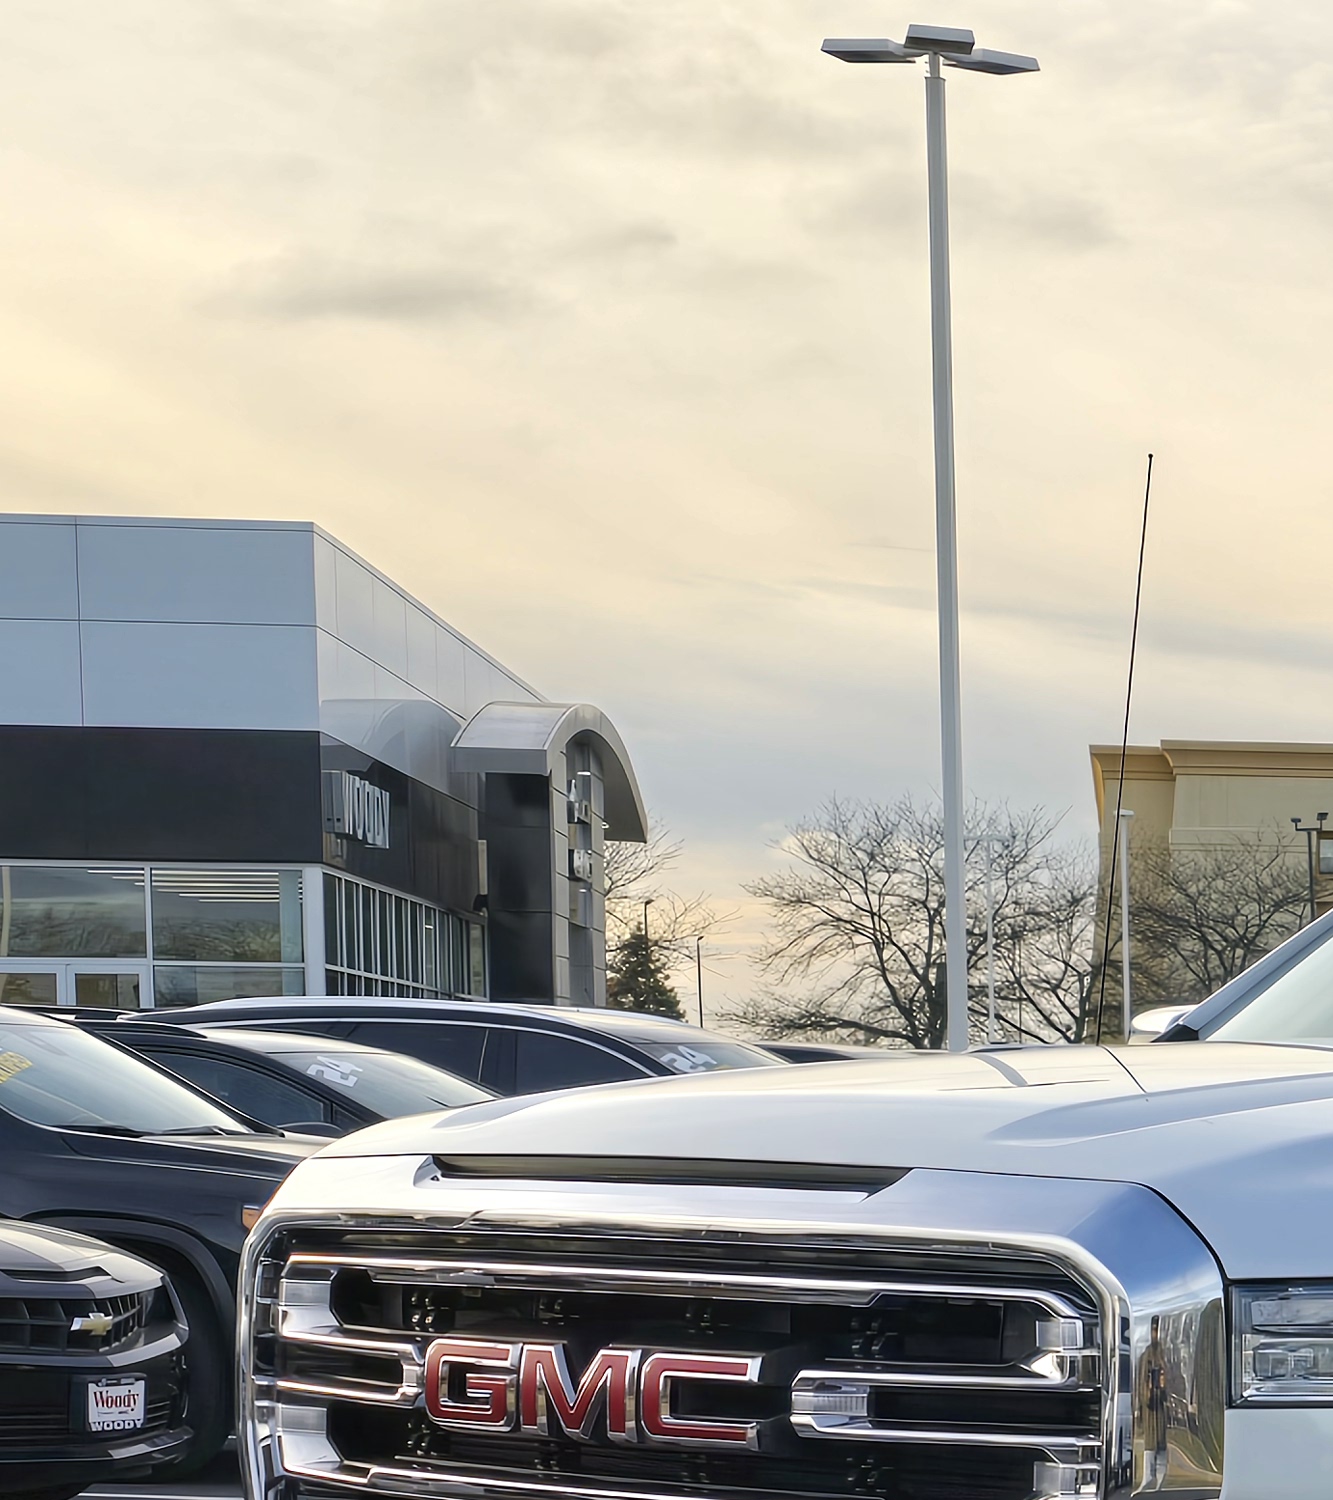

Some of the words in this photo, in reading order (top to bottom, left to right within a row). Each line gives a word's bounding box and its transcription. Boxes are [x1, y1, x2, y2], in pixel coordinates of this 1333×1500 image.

[306, 1055, 364, 1088] 24
[93, 1389, 139, 1412] Woody
[424, 1338, 763, 1452] GMC
[91, 1419, 142, 1432] WOODY
